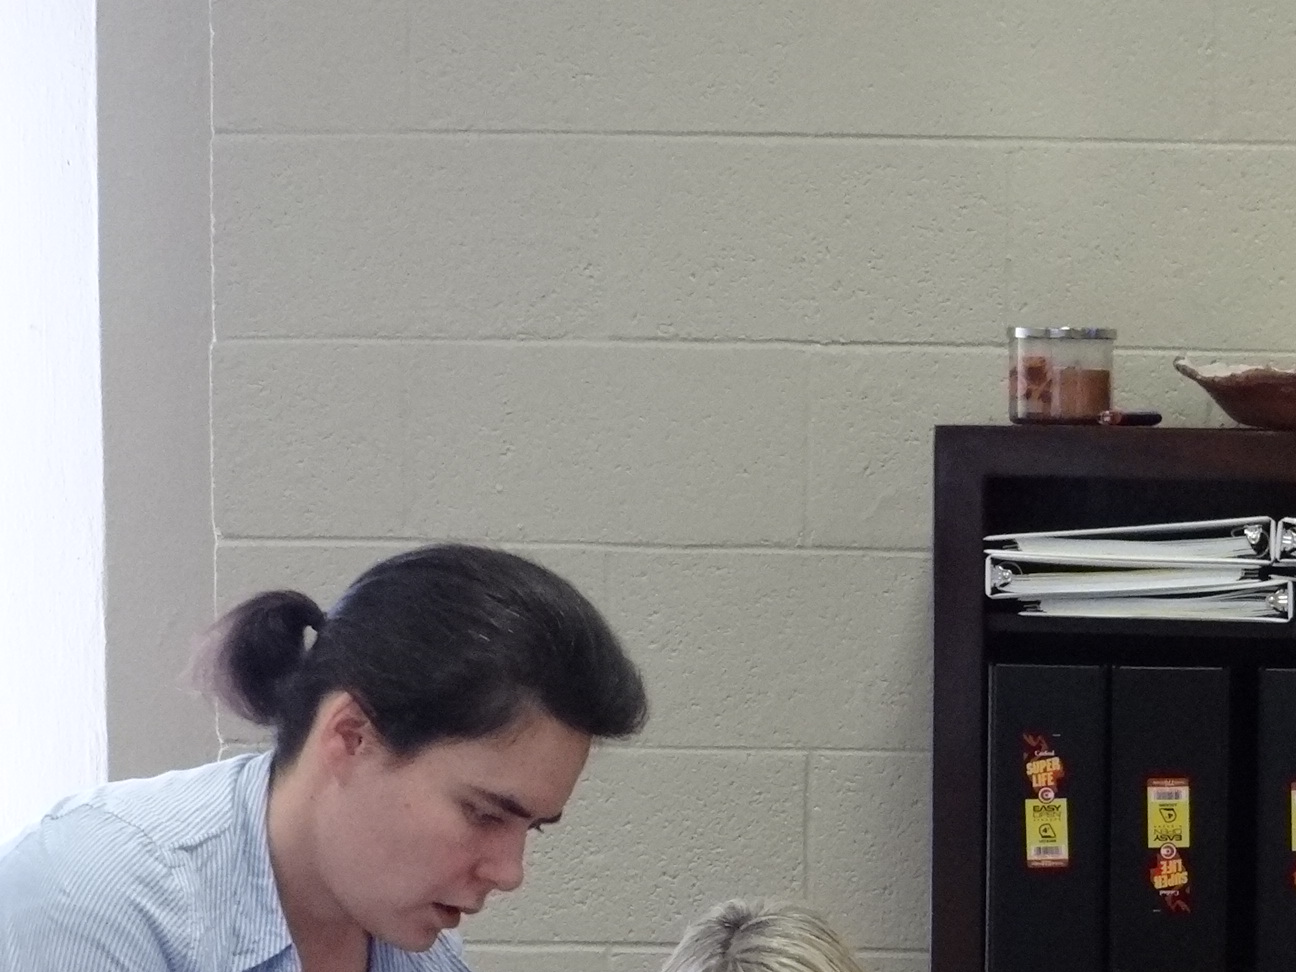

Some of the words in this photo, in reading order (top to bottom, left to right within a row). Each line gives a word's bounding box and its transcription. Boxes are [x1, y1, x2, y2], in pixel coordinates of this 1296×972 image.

[1026, 756, 1061, 775] SUPER
[1032, 771, 1054, 788] LIFE
[1160, 859, 1182, 874] LIFE
[1153, 871, 1188, 890] SUPER
